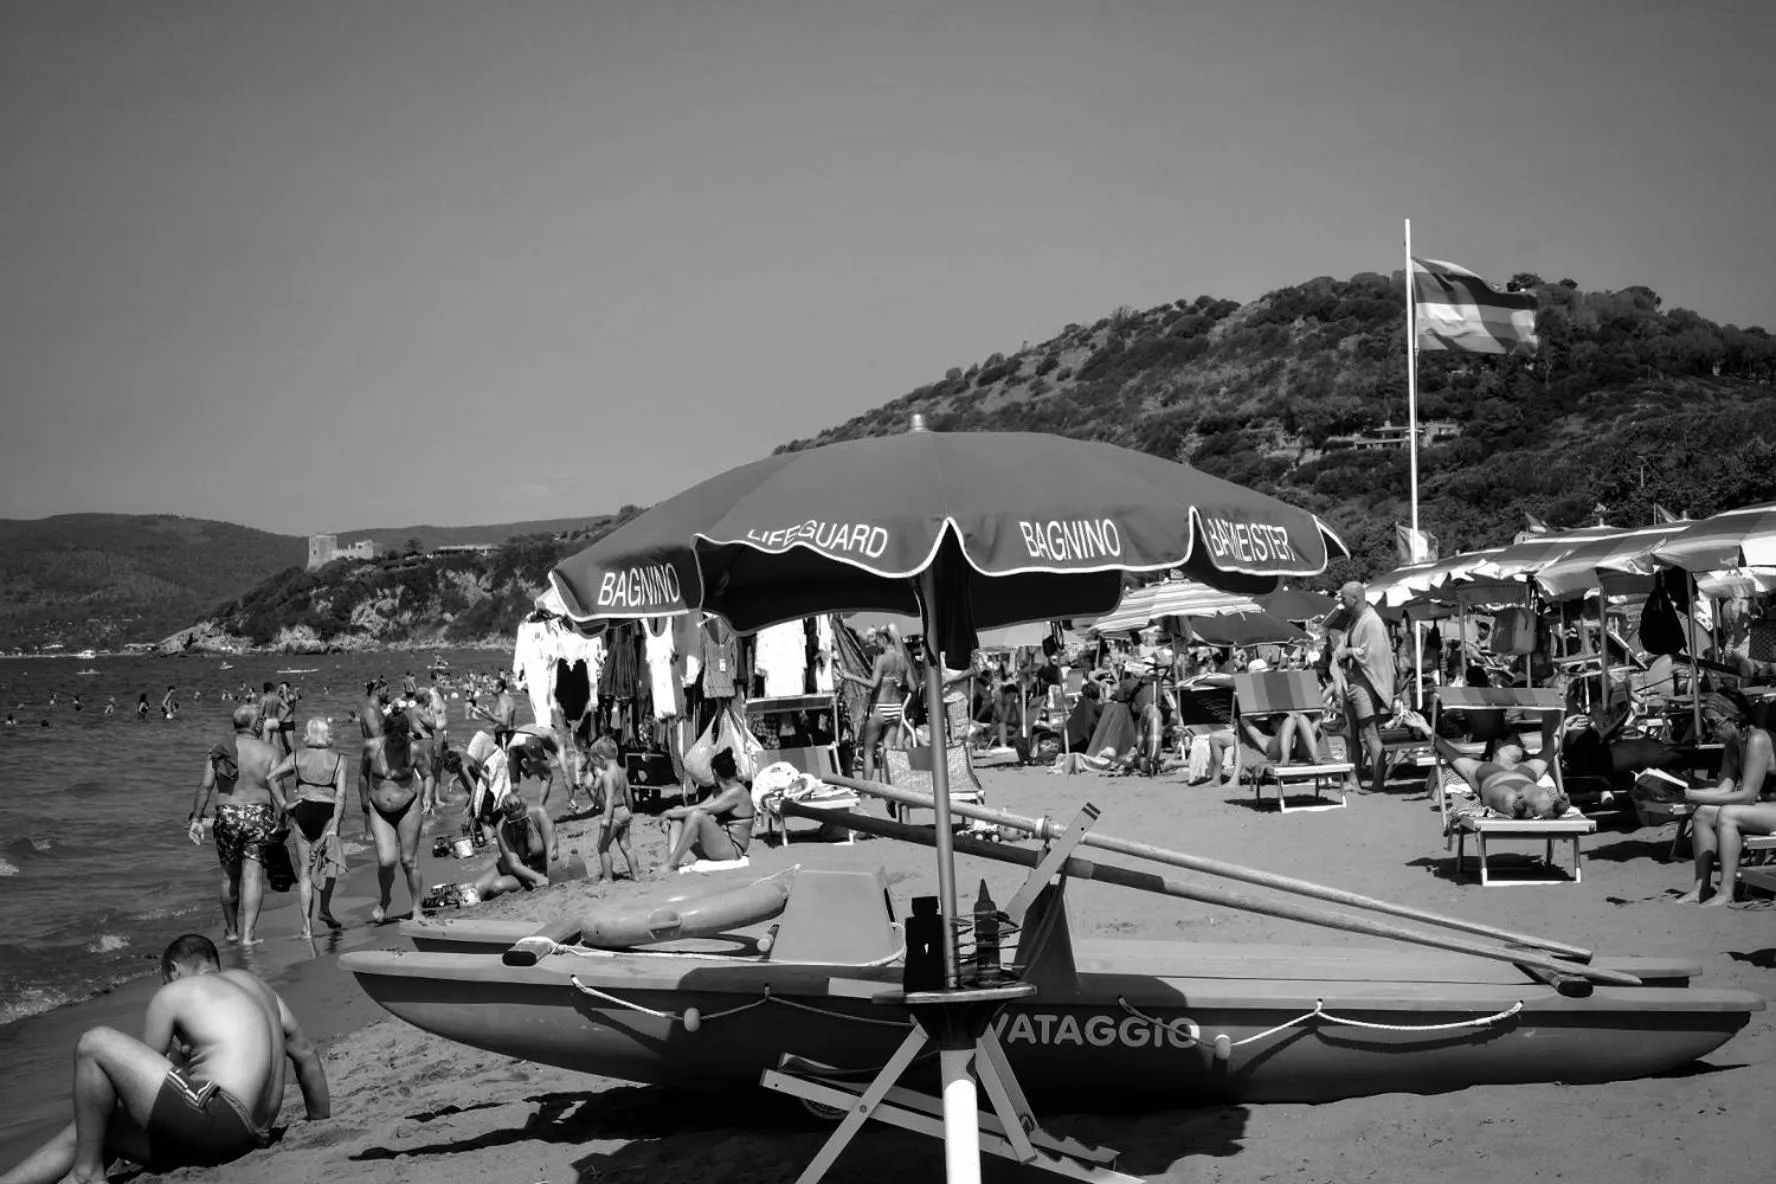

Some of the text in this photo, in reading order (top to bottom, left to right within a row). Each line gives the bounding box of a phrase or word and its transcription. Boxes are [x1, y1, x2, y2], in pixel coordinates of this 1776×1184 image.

[747, 519, 888, 558] LIFEGUARD
[1019, 518, 1121, 561] BAGNINO
[598, 562, 680, 607] BAGNINO
